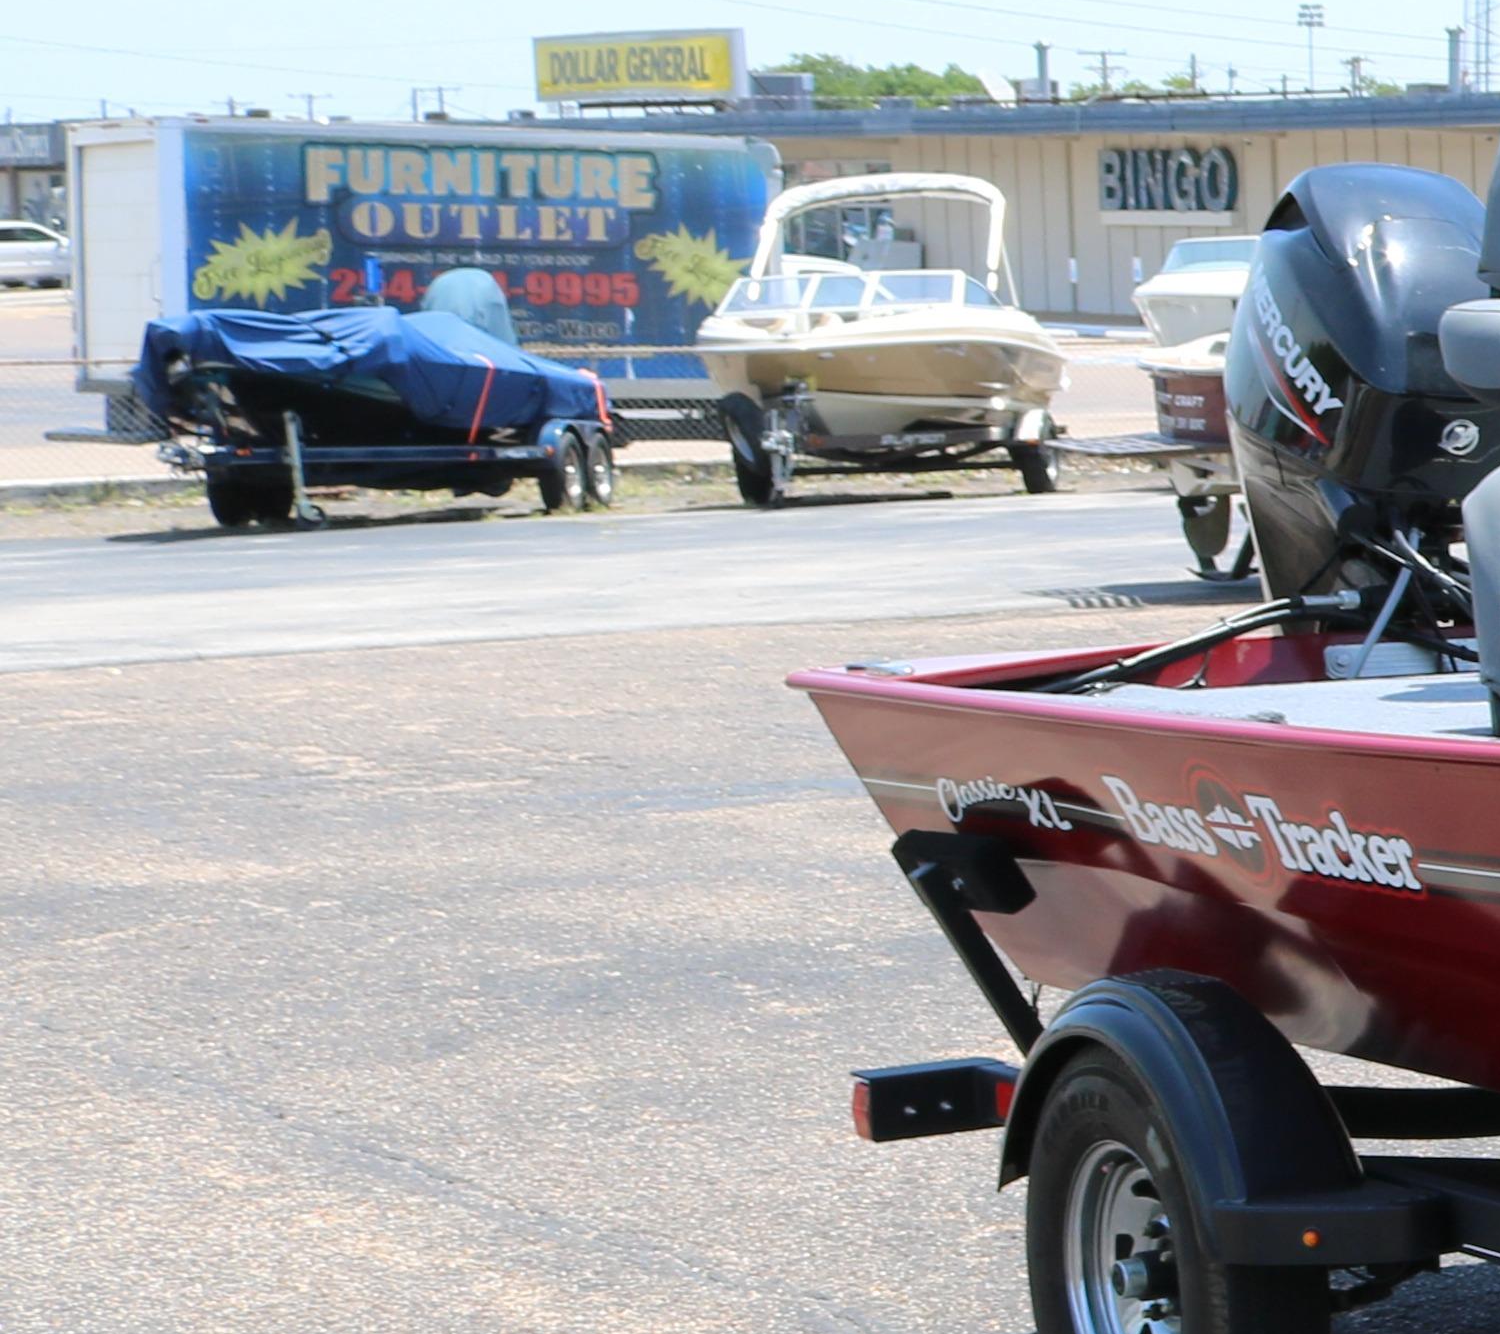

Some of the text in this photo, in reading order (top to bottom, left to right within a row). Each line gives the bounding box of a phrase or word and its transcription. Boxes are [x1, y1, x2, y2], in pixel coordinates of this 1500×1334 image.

[550, 45, 710, 85] DOLLAR GENERAL
[305, 146, 656, 209] FURNITURE
[1101, 146, 1239, 212] BINGO
[351, 200, 617, 242] OUTLET
[1251, 264, 1344, 416] MERCURY
[937, 775, 1073, 831] Classic XL
[1102, 774, 1424, 891] Bass Tracker
